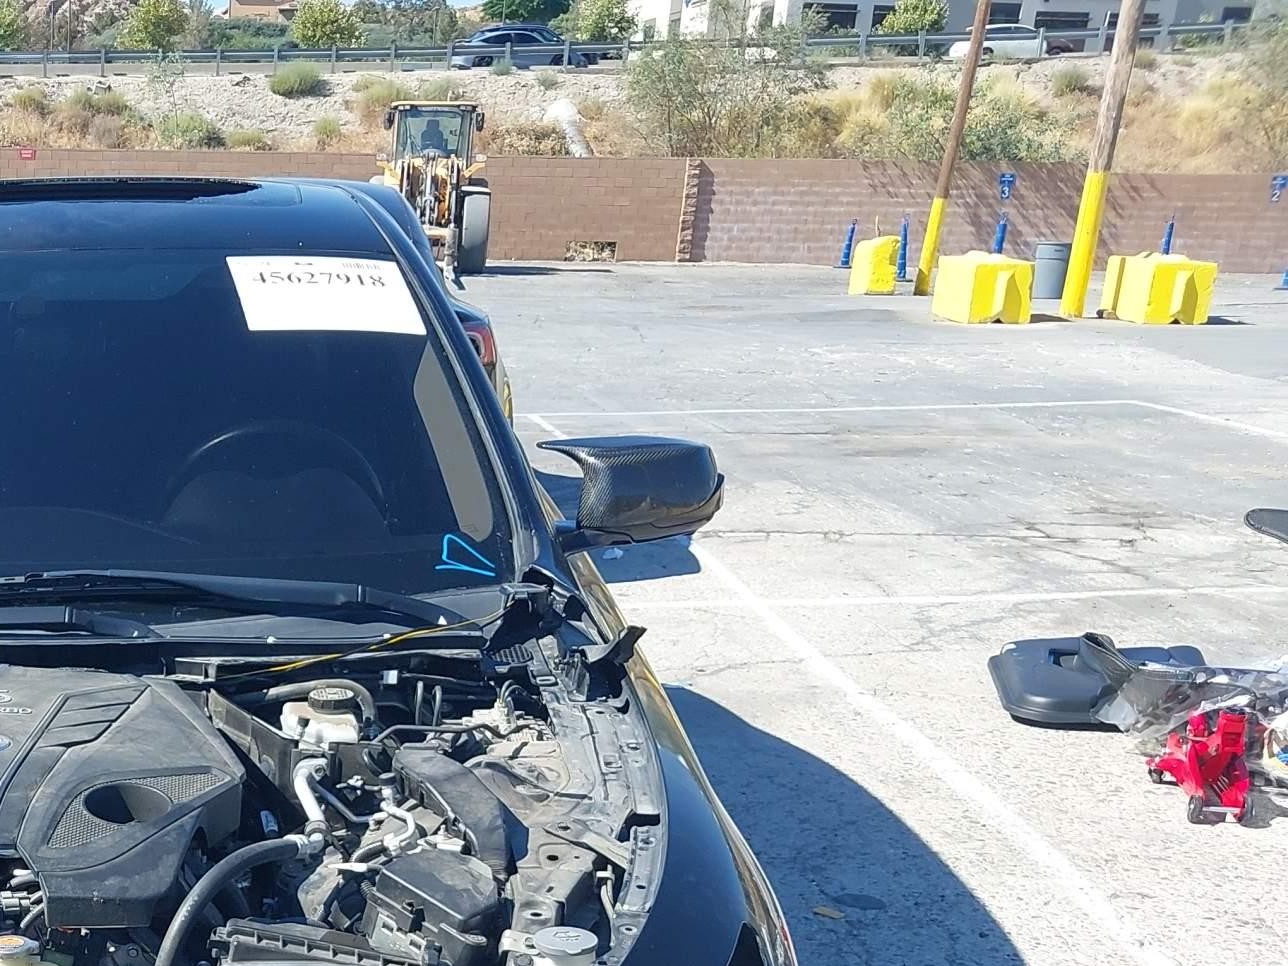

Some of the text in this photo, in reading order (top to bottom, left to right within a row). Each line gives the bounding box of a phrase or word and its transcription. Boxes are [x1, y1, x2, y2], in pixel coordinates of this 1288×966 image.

[1001, 186, 1009, 198] 3
[1271, 190, 1281, 201] 2
[253, 271, 387, 288] 45627918
